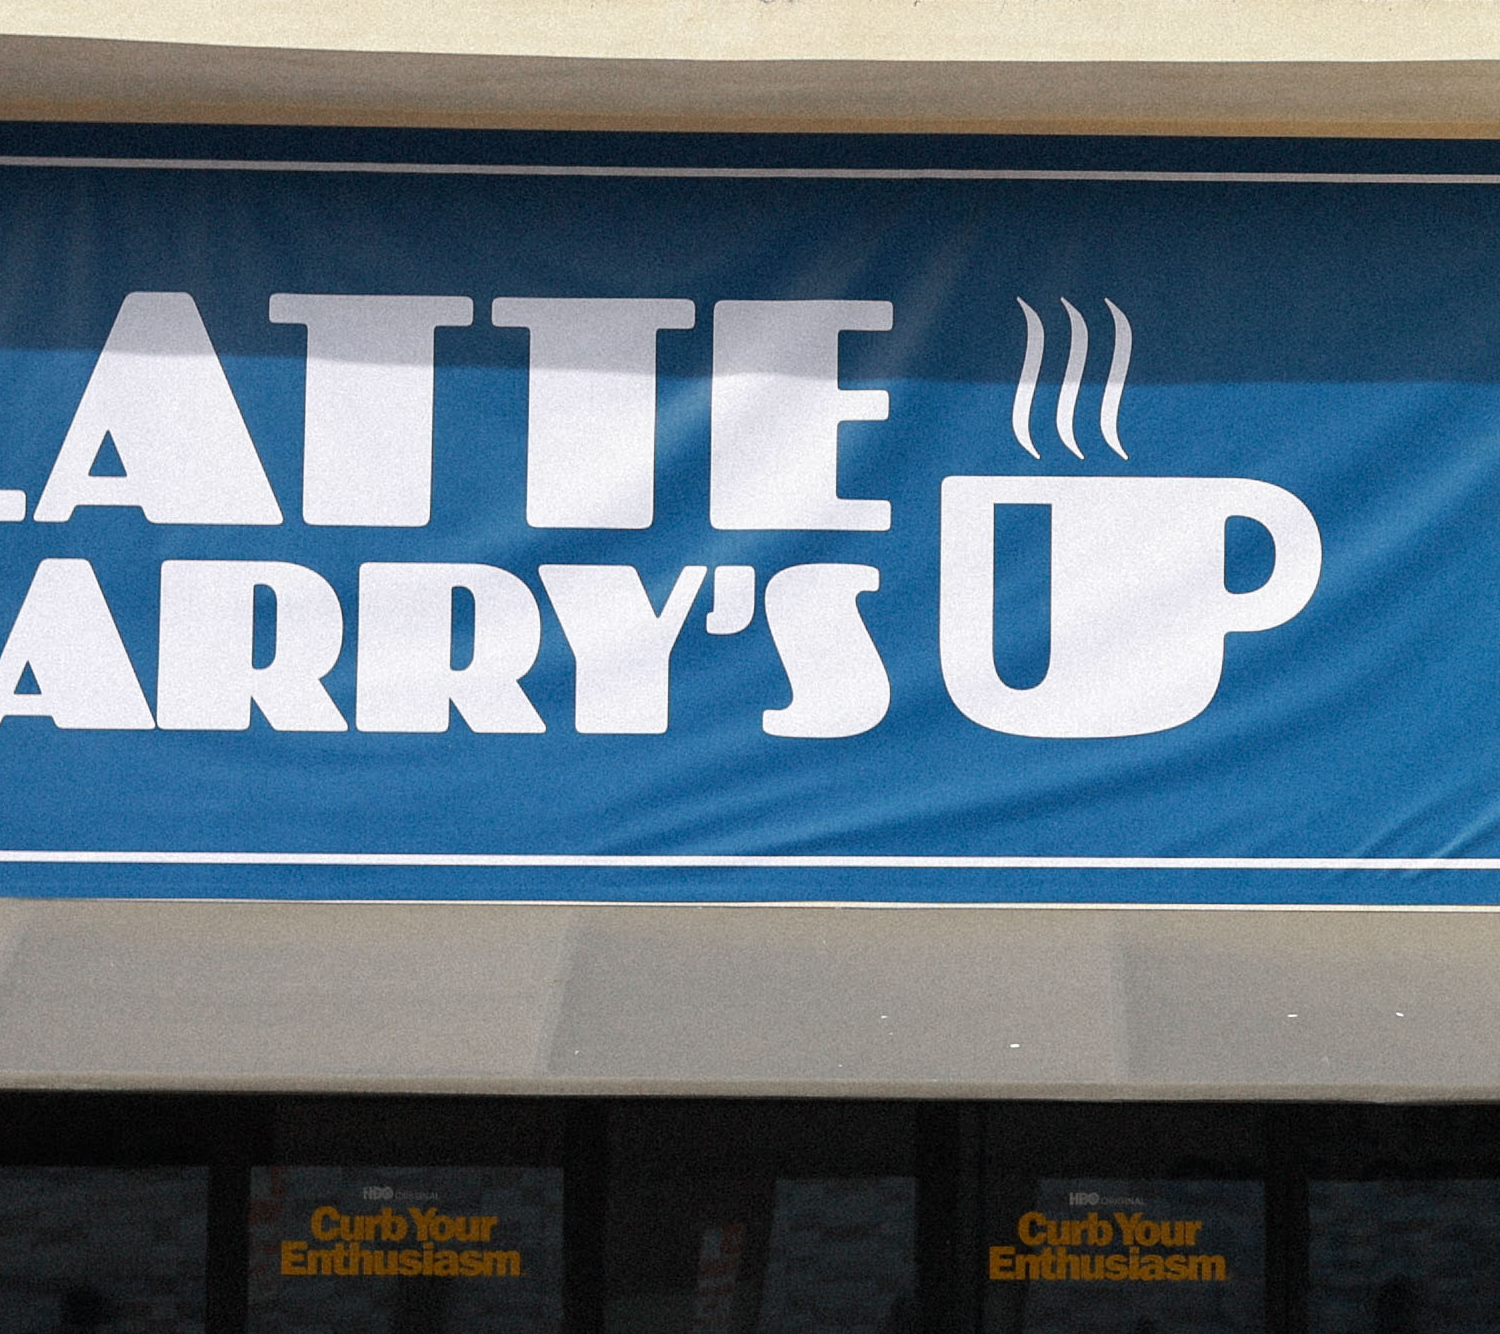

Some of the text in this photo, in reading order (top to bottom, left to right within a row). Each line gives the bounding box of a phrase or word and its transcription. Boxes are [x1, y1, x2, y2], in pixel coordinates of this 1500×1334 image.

[938, 474, 1323, 738] UP
[1069, 1192, 1099, 1206] HBO
[311, 1205, 497, 1242] Curb Your
[1017, 1211, 1202, 1247] Curb Your
[281, 1241, 521, 1276] Enthusiasm
[989, 1246, 1227, 1281] Enthusiasm
